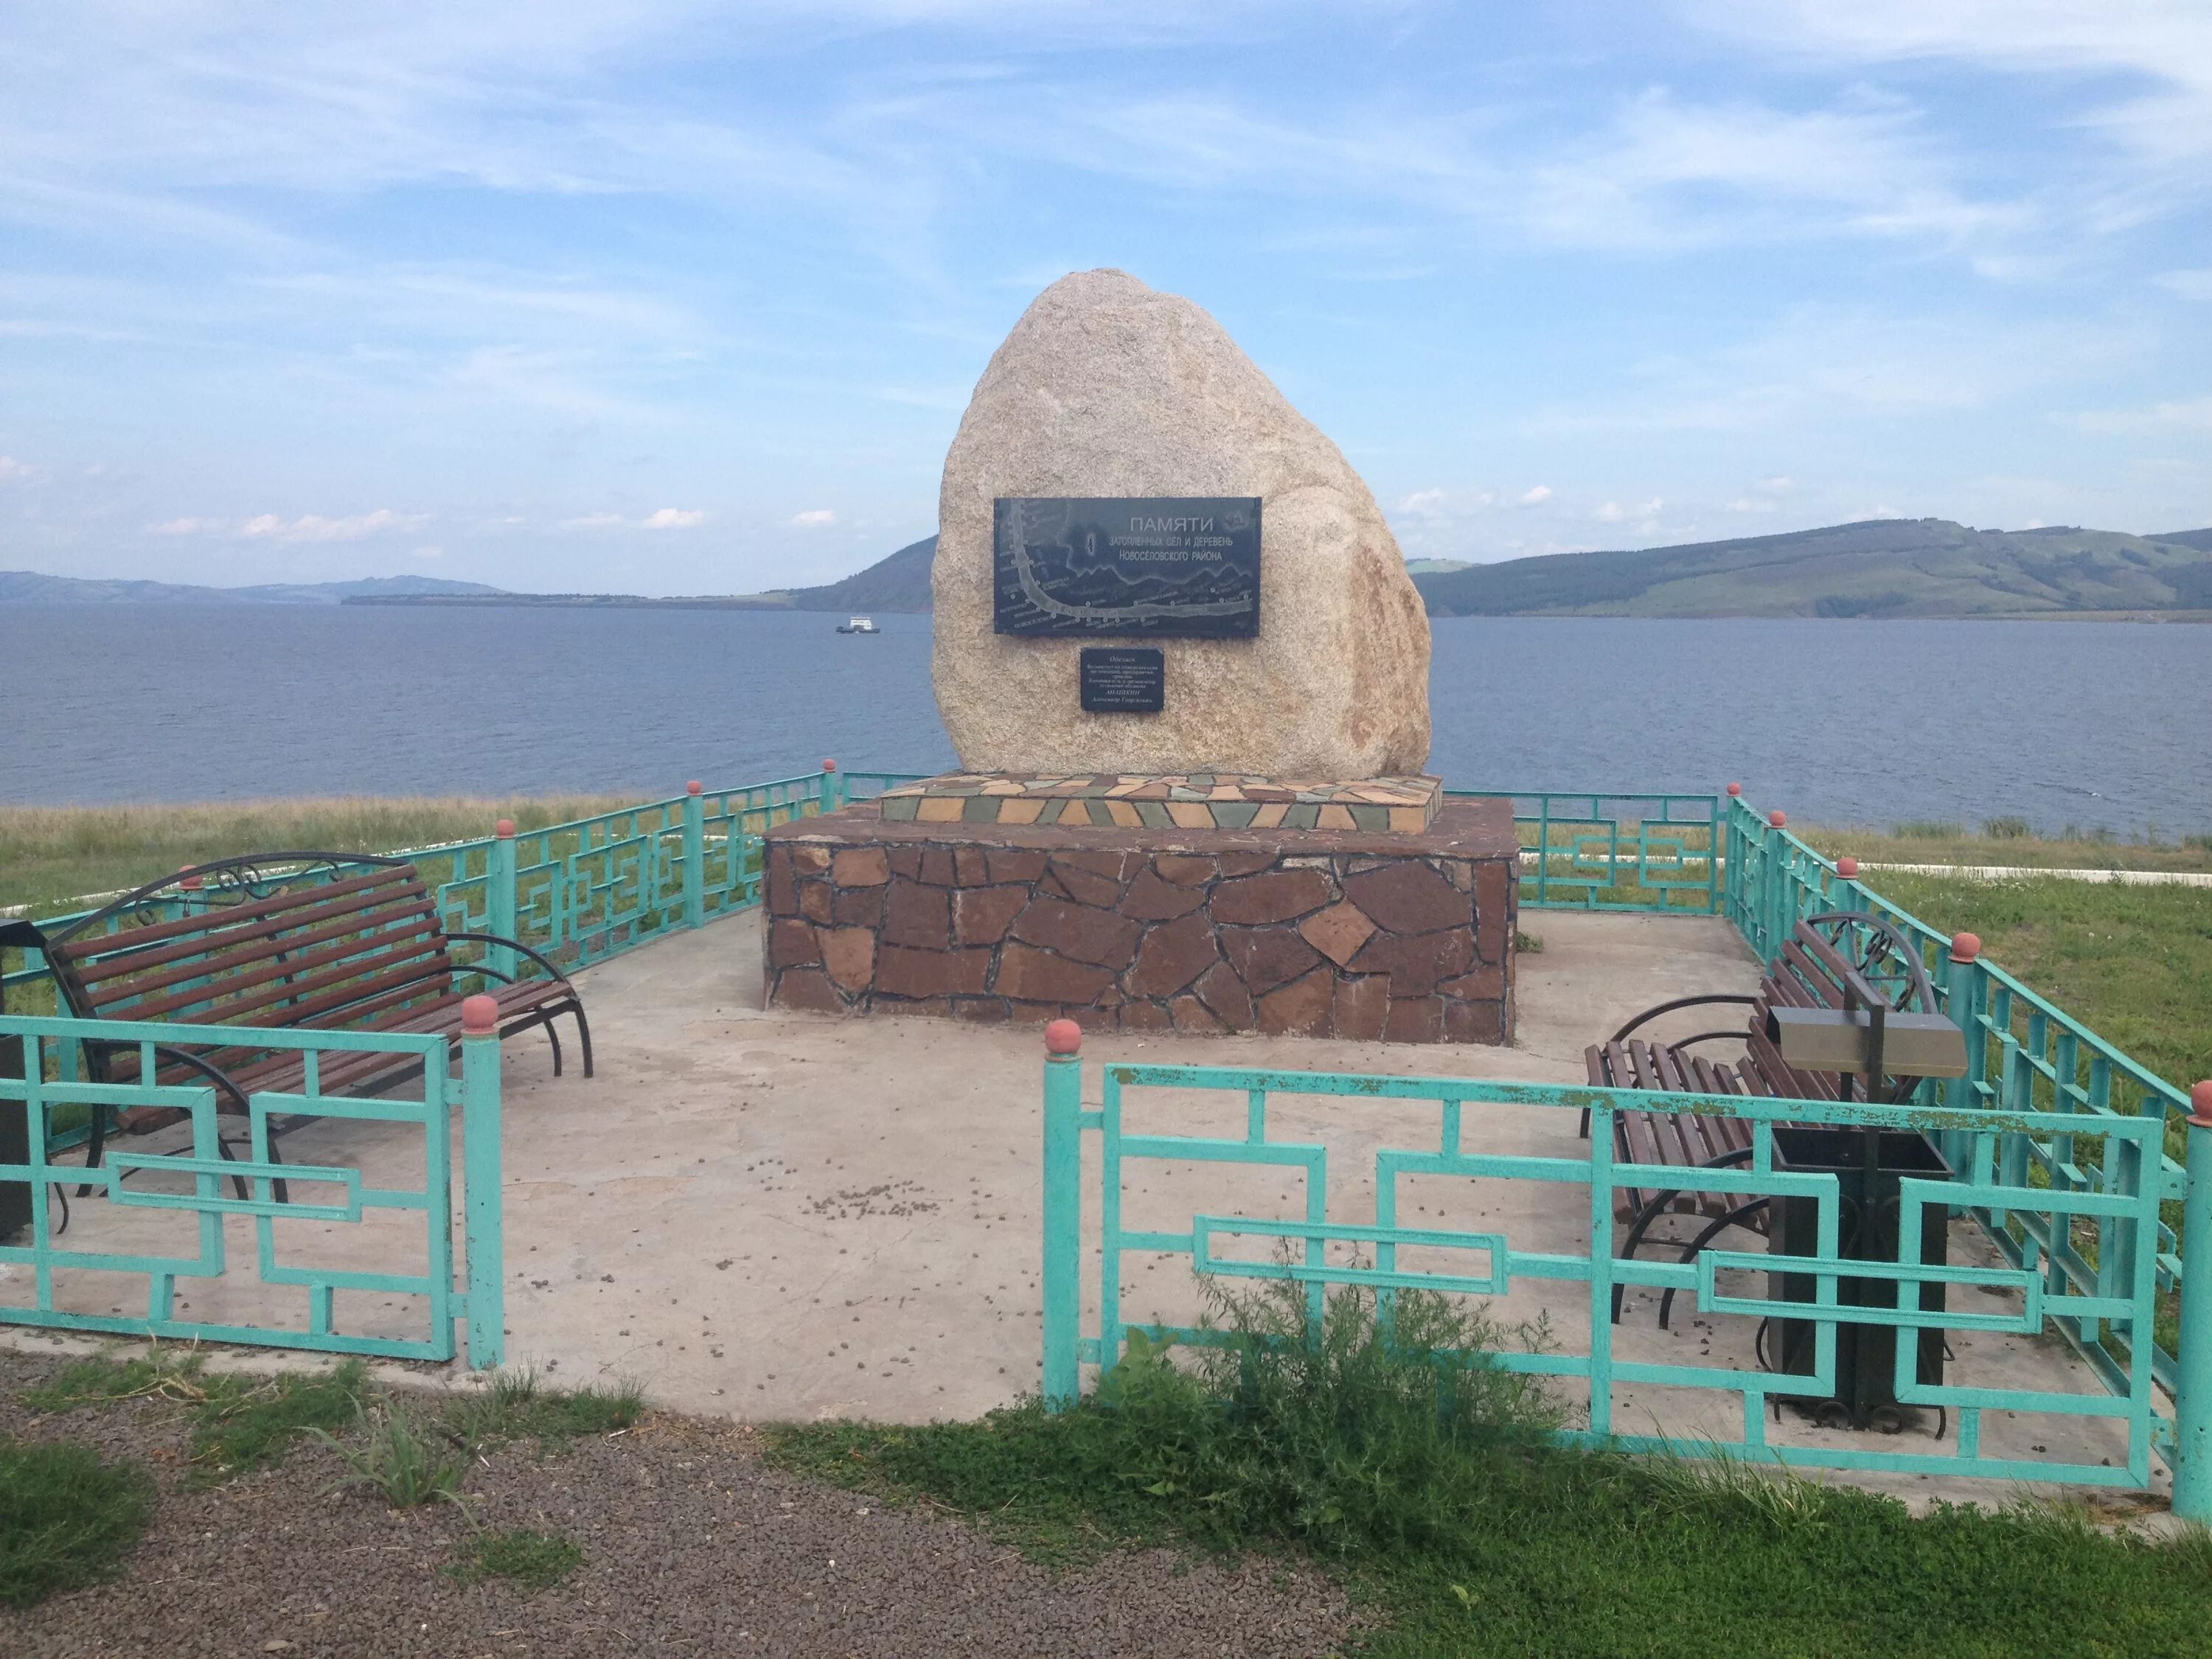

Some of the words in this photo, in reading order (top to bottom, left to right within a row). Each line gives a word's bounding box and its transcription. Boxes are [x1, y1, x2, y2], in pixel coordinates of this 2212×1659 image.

[1130, 517, 1214, 532] ПАМЯТИ
[1108, 536, 1163, 546] ЗАТОПЛЕННЫХ
[1184, 536, 1191, 546] И
[1192, 536, 1234, 548] ДЕРЕВЕНЬ
[1192, 549, 1222, 561] РАЙОНА
